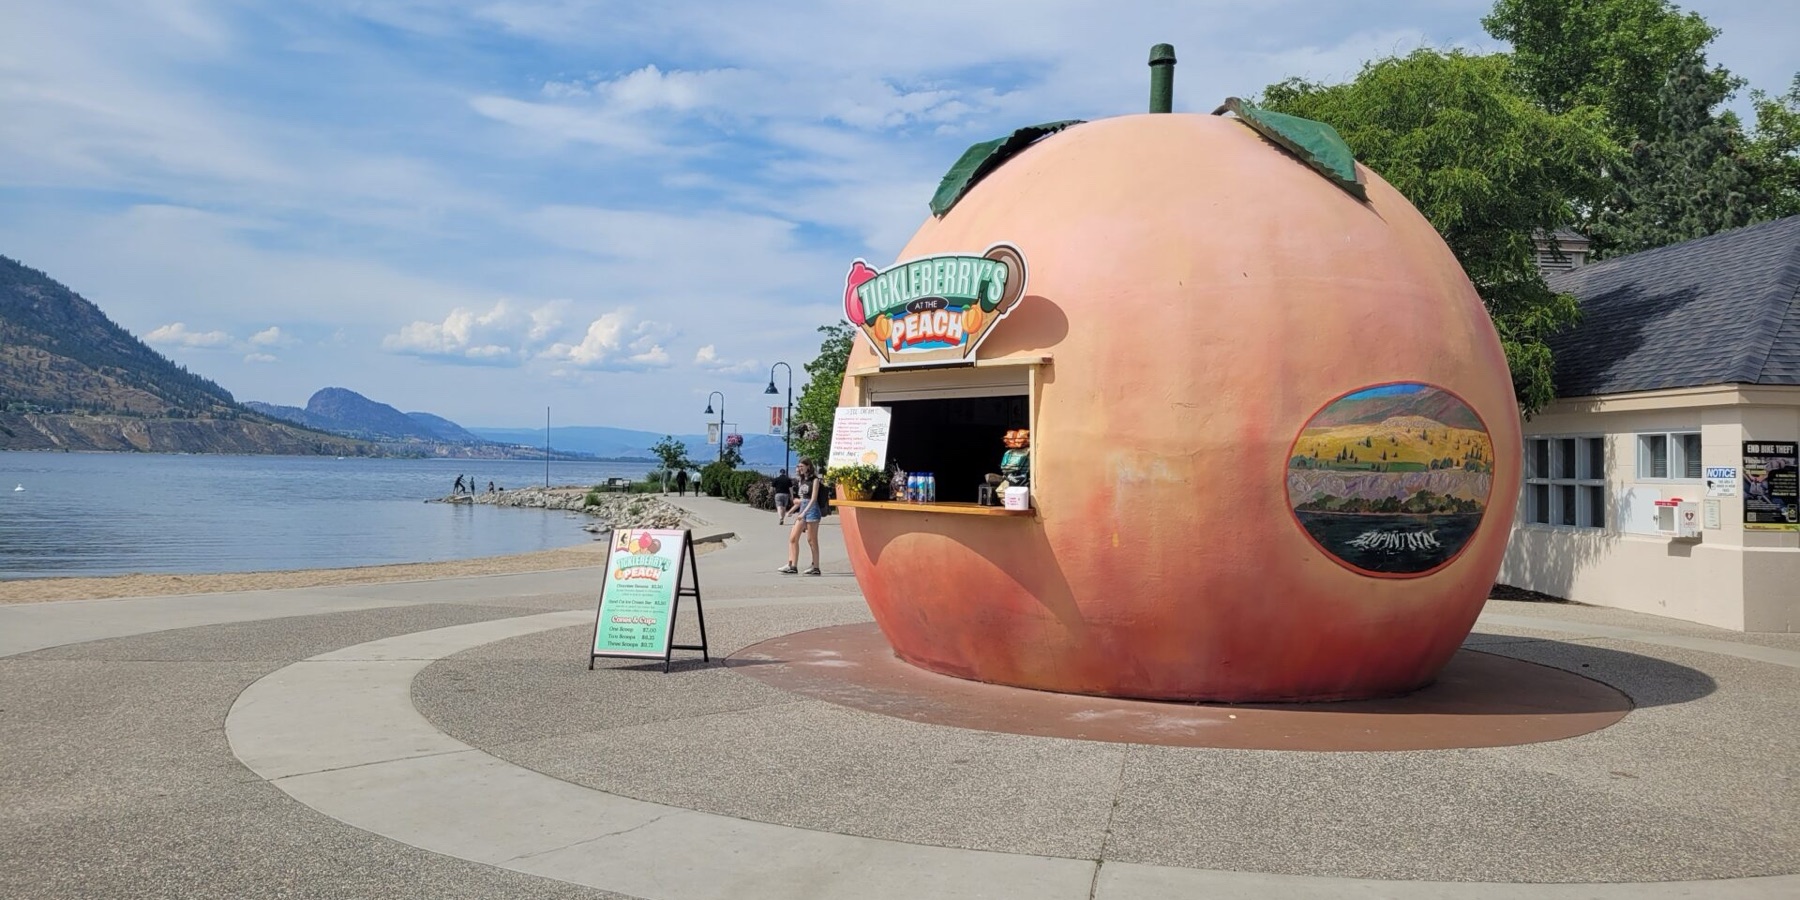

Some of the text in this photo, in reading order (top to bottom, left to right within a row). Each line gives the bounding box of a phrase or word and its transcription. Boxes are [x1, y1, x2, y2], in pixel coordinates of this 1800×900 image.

[857, 256, 1008, 320] TICKLEBERRY'S
[914, 300, 938, 310] AT THE
[891, 311, 963, 350] PEACH
[1747, 444, 1794, 454] END BIKE THEFT
[1707, 468, 1736, 478] NOTICE
[616, 555, 672, 572] TICKLEBERRY'S
[624, 568, 662, 580] PEACH
